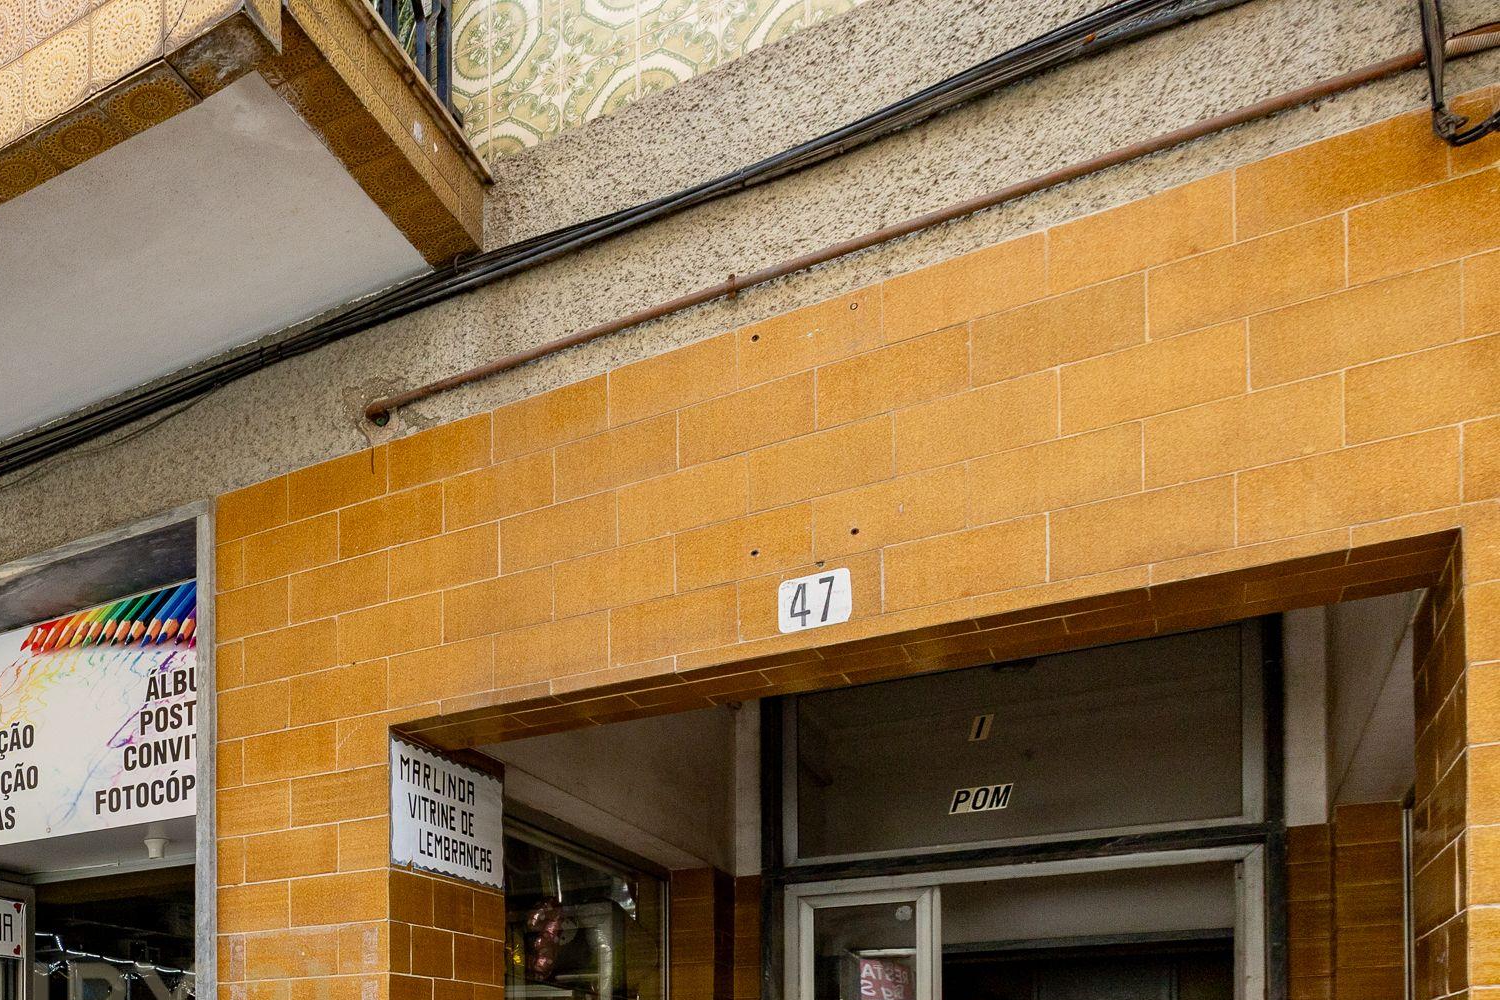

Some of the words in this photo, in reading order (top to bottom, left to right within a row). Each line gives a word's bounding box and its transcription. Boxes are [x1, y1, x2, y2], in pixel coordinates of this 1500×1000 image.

[789, 575, 835, 627] 47
[140, 700, 197, 736] POST
[95, 770, 197, 816] FOTOCÓP
[399, 753, 476, 806] MARLINDA
[951, 784, 1013, 813] POM
[407, 792, 457, 832] VITRINE
[460, 809, 476, 838] DE
[419, 828, 493, 874] LEMBRANÇAS
